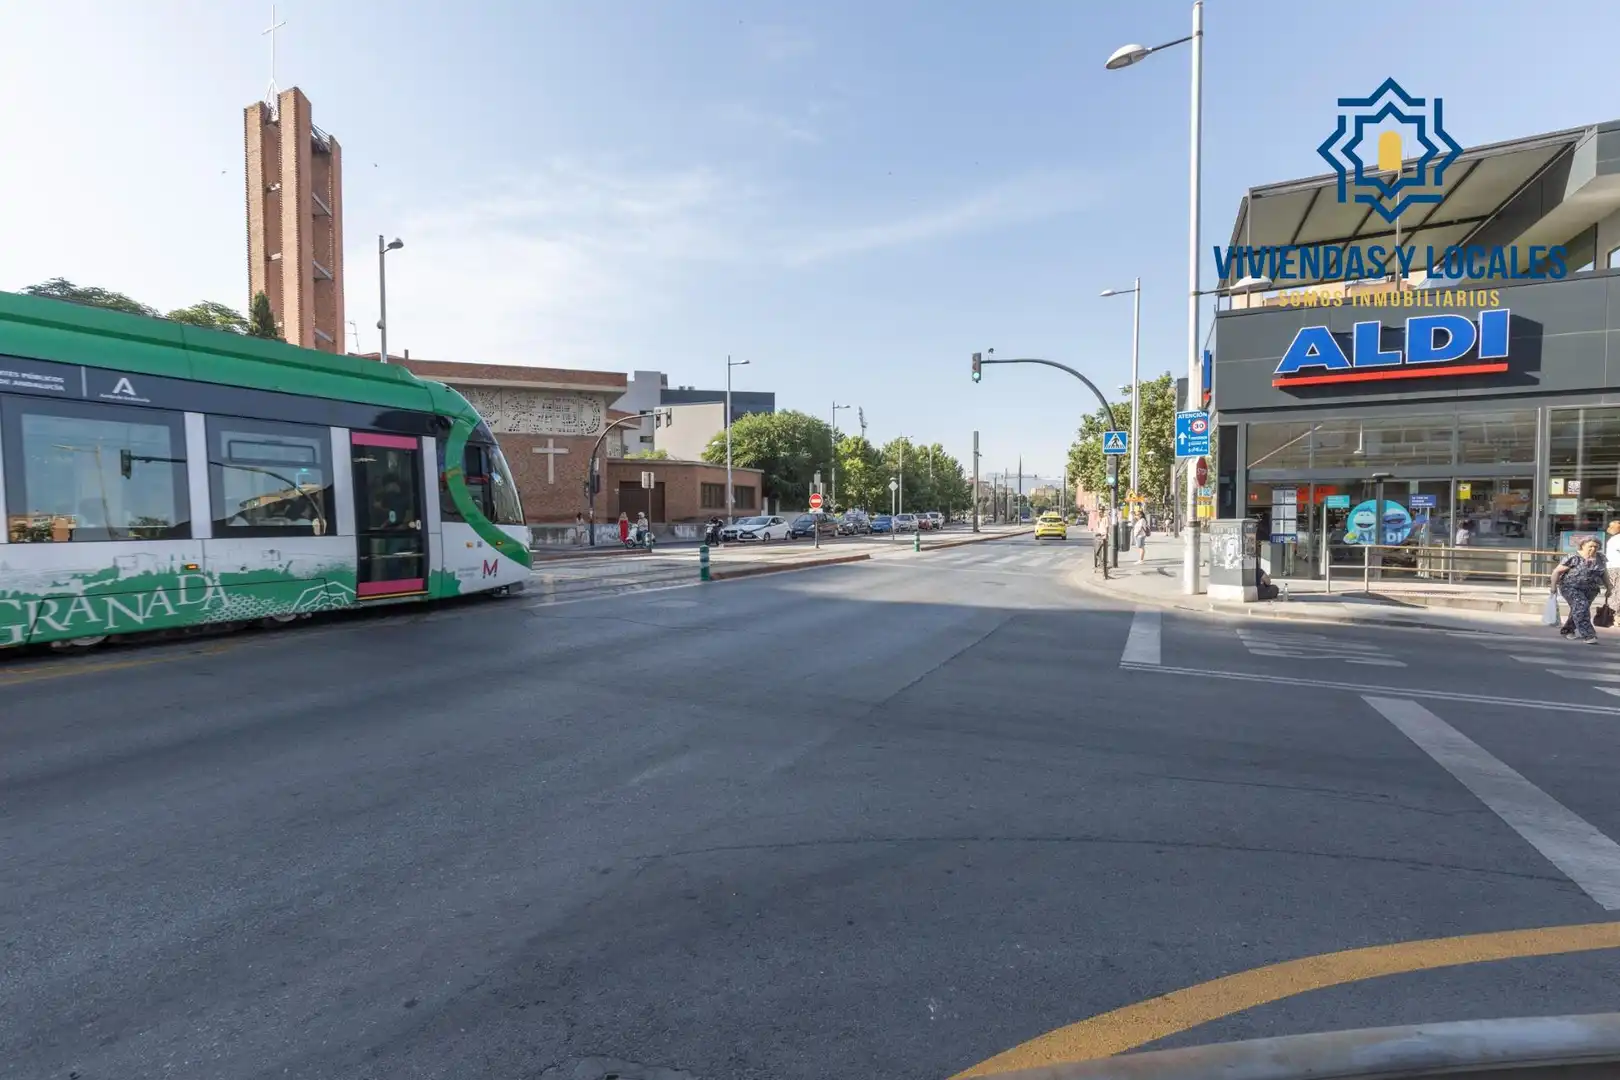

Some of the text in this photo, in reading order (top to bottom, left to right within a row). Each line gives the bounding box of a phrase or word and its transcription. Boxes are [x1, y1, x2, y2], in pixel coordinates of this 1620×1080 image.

[1273, 308, 1511, 375] ALDI
[1177, 411, 1208, 419] ATENCIÓN
[0, 573, 230, 649] GRANADA
